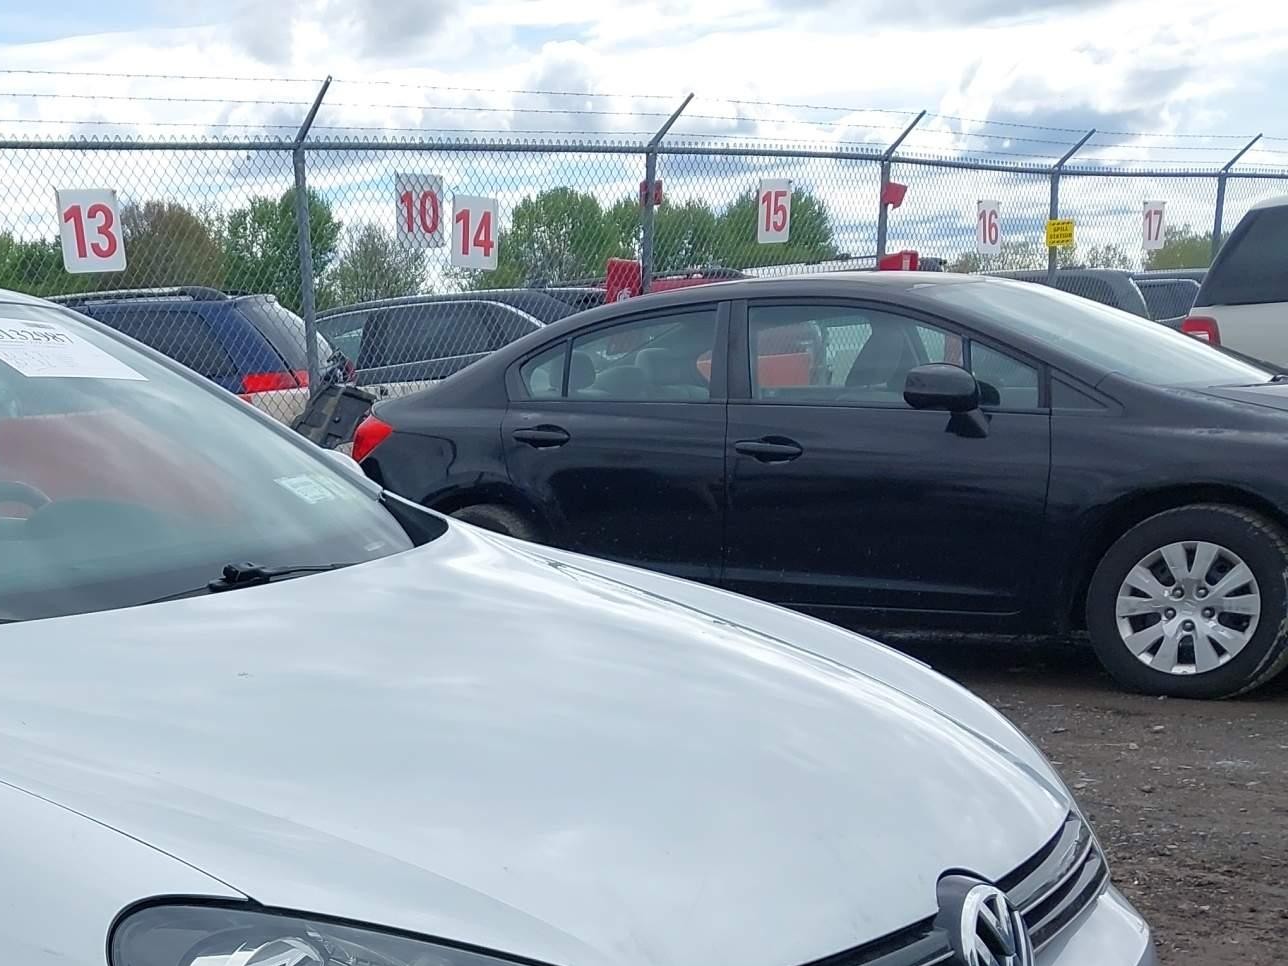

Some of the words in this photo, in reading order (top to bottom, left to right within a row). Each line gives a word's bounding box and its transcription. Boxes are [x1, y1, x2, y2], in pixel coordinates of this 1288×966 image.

[63, 203, 118, 258] 13
[402, 191, 438, 233] 10
[763, 191, 787, 231] 15
[979, 209, 999, 245] 16
[1145, 209, 1163, 242] 17
[456, 209, 494, 256] 14
